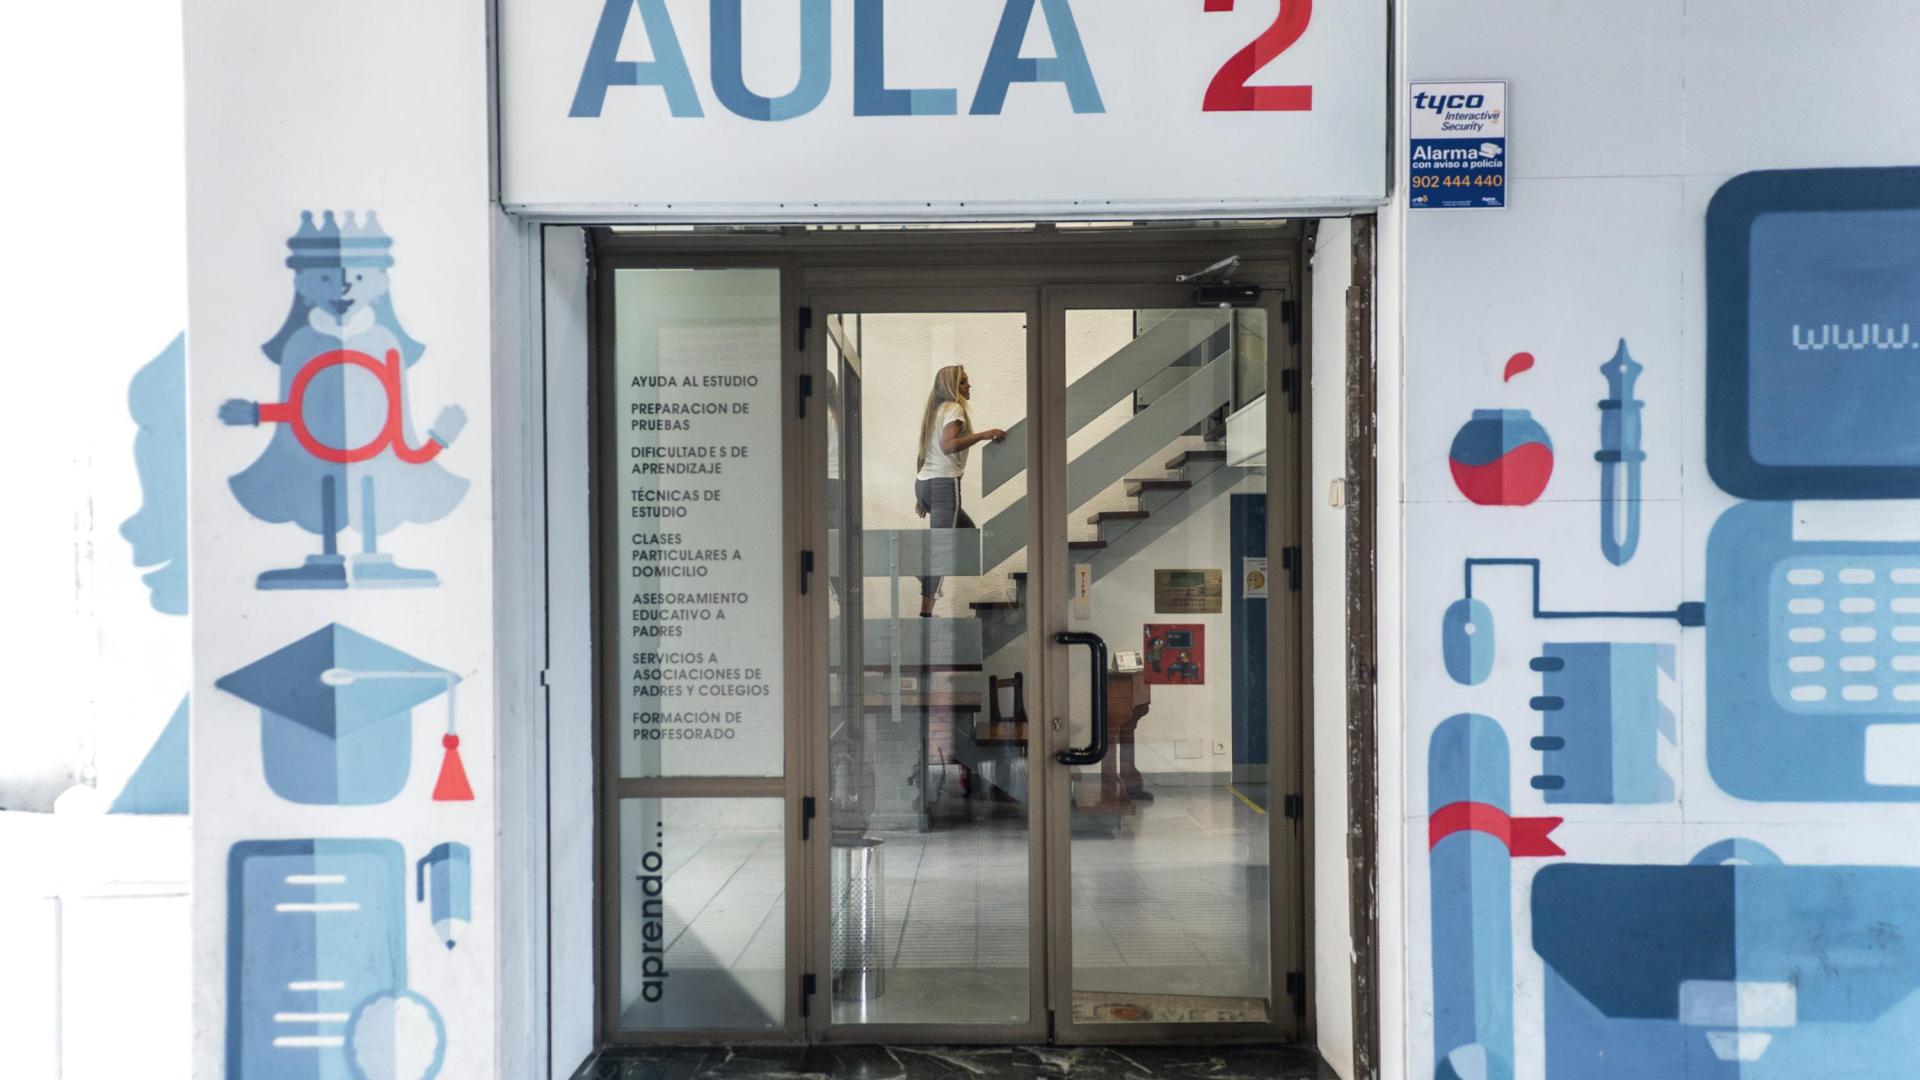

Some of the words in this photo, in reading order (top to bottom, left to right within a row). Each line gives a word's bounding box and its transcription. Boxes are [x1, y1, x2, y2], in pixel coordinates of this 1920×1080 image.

[568, 0, 1106, 122] AULA
[1202, 0, 1314, 112] 2
[1413, 91, 1485, 115] tyco
[1445, 110, 1500, 121] Interactive
[1441, 121, 1484, 132] Security
[1413, 145, 1478, 160] Alarma
[1412, 161, 1432, 169] con
[1433, 160, 1460, 168] aviso
[1470, 159, 1503, 170] policía
[1412, 175, 1440, 188] 902
[1442, 175, 1471, 188] 444
[1474, 174, 1503, 187] 440
[631, 376, 677, 387] AYUDA
[682, 376, 698, 387] AL
[703, 376, 758, 387] ESTUDIO
[631, 403, 728, 414] PREPARACION
[732, 403, 749, 414] DE
[631, 420, 690, 430] PRUEBAS
[631, 446, 726, 458] DIFICULTADES
[732, 446, 748, 457] DE
[632, 463, 722, 474] APRENDIZAJE
[632, 486, 699, 501] TÉCNICAS
[704, 490, 720, 501] DE
[632, 506, 687, 518] ESTUDIO
[632, 534, 682, 544] CLASES
[632, 550, 727, 561] PARTICULARES
[732, 550, 741, 560] A
[632, 566, 708, 577] DOMICILIO
[633, 593, 748, 604] ASESORAMIENTO
[633, 609, 711, 620] EDUCATIVO
[716, 609, 725, 620] A
[633, 626, 682, 637] PADRES
[633, 653, 703, 664] SERVICIOS
[709, 653, 718, 663] A
[633, 669, 740, 680] ASOCIACIONES
[745, 668, 762, 679] DE
[633, 685, 682, 696] PADRES
[688, 685, 694, 695] Y
[699, 685, 770, 696] COLEGIOS
[725, 712, 742, 723] DE
[633, 729, 735, 740] PROFESORADO
